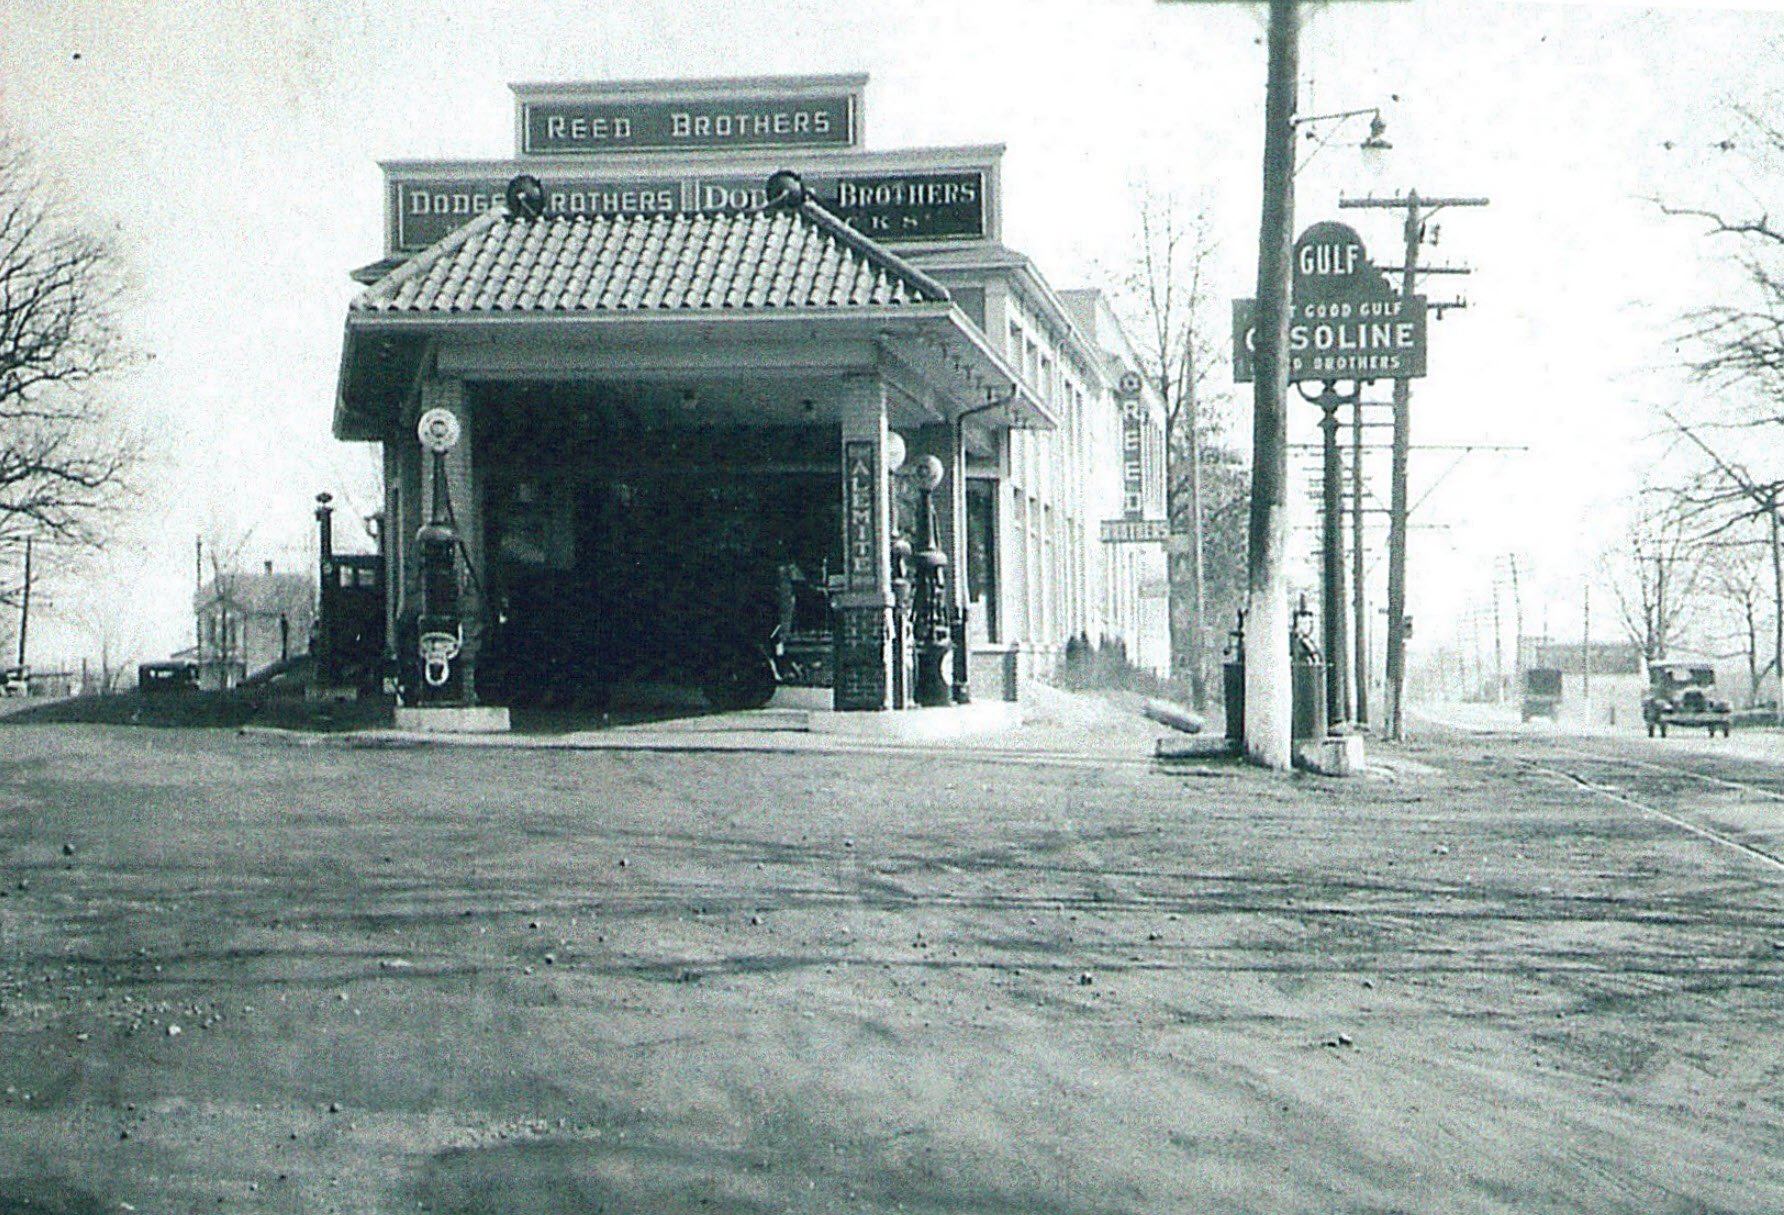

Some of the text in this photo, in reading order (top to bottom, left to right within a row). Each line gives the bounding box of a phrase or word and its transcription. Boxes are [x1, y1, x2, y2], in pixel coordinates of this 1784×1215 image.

[548, 111, 829, 139] REED BROTHERS
[544, 189, 673, 213] ROTHERS
[705, 181, 975, 211] DOD BROTHERS
[1301, 244, 1359, 275] GULF
[1304, 303, 1351, 319] GOOD
[1360, 302, 1402, 316] GULF
[1246, 322, 1414, 351] SOLINE
[1314, 355, 1400, 370] BROTHERS
[1124, 401, 1141, 511] REED
[851, 459, 871, 573] ALEMITE
